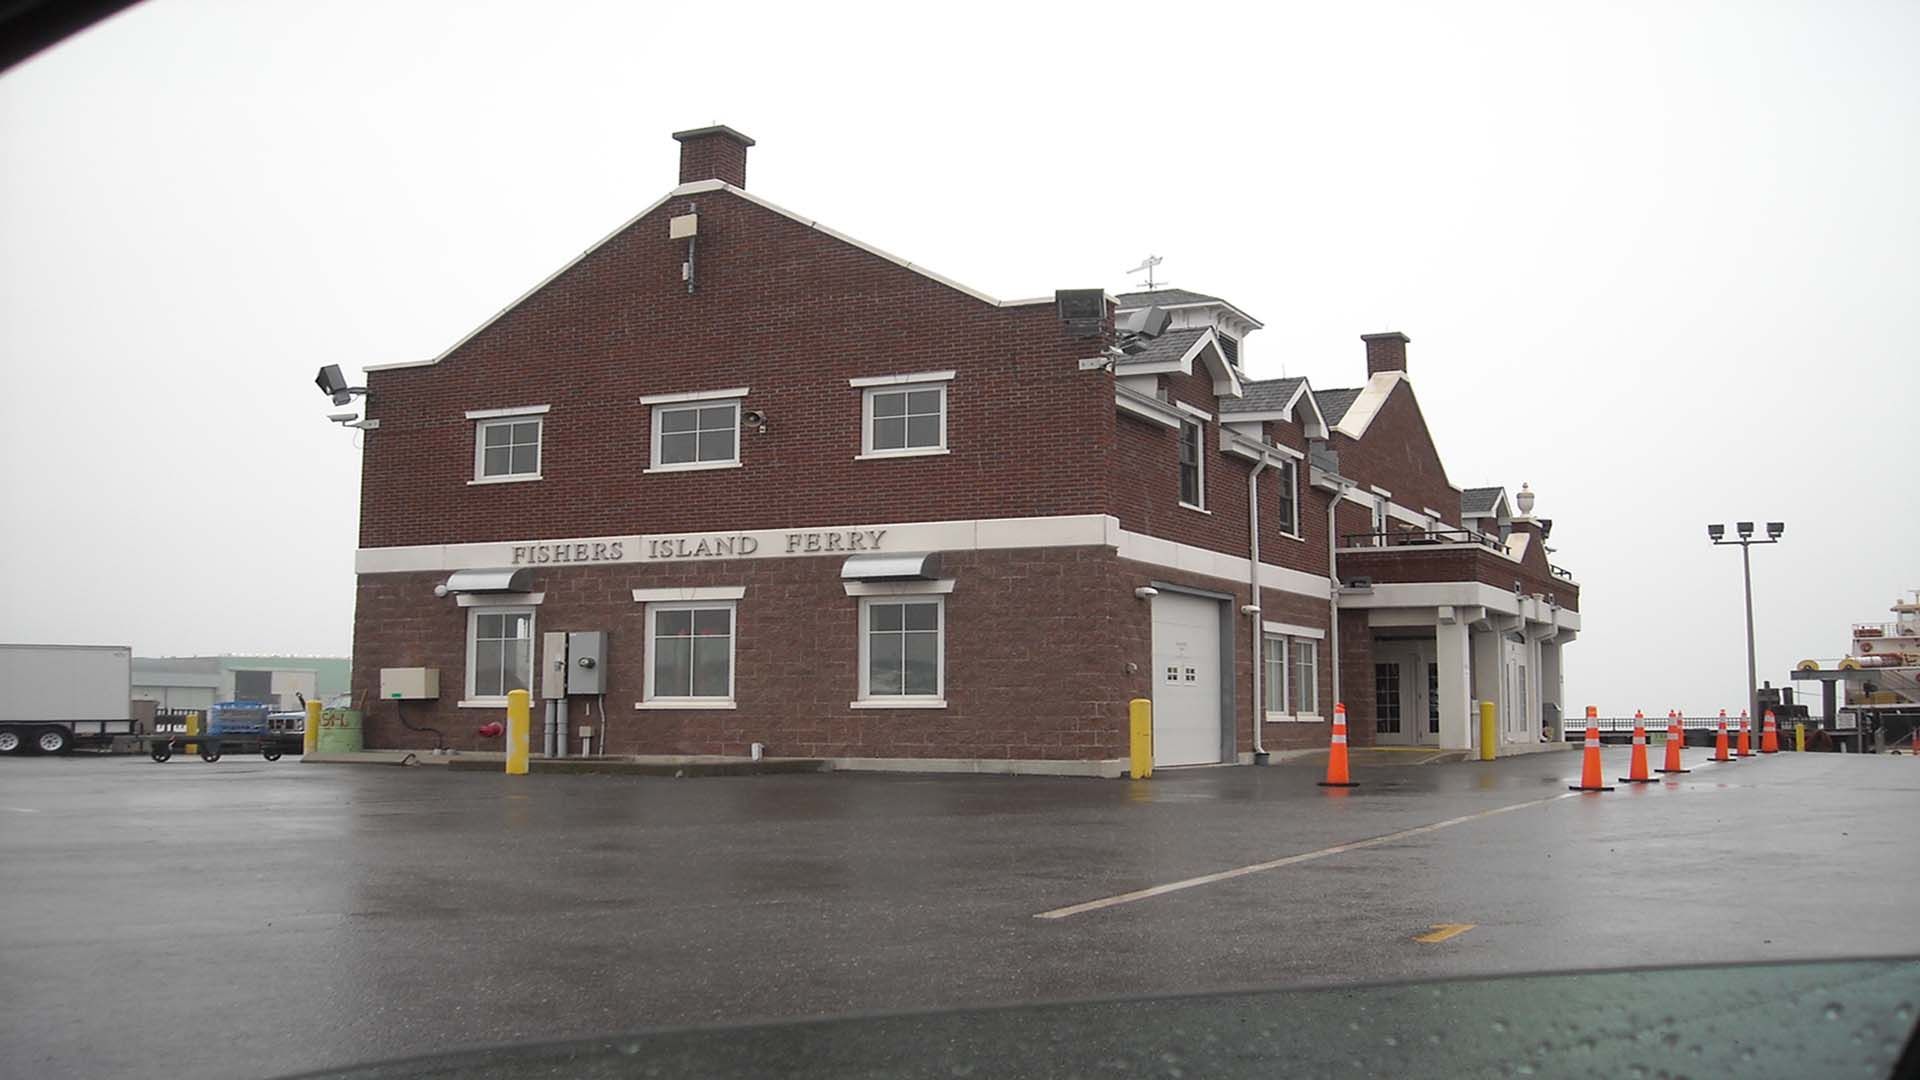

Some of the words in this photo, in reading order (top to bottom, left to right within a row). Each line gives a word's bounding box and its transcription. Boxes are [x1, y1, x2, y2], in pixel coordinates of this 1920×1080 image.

[512, 540, 623, 565] FISHERS
[649, 534, 758, 559] ISLAND
[785, 529, 887, 554] FERRY
